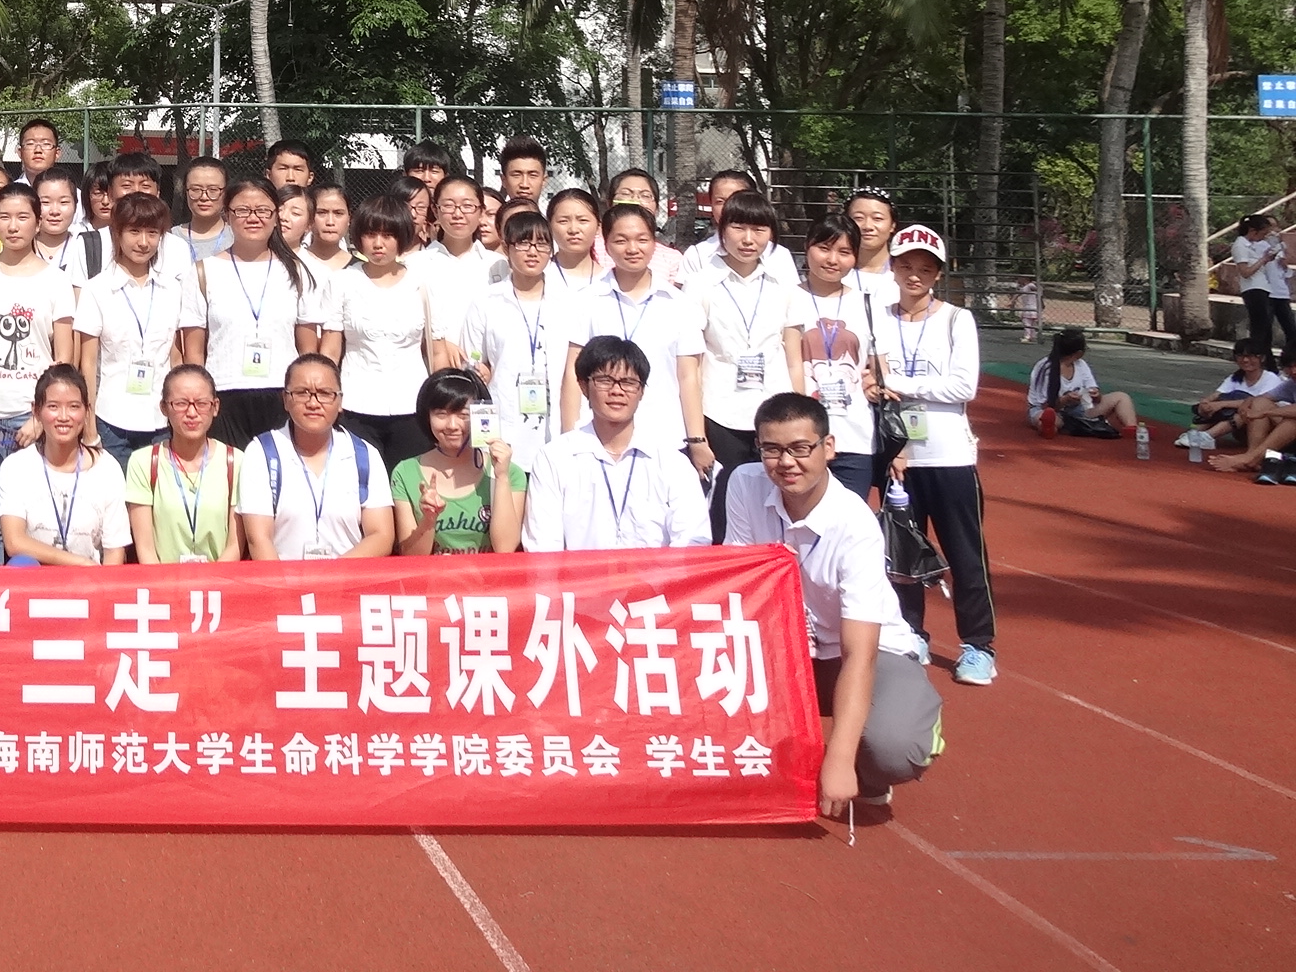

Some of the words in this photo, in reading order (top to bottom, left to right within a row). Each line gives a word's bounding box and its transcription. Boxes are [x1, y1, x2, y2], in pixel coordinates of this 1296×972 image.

[663, 96, 694, 106] 后果自负
[899, 229, 939, 250] PINK
